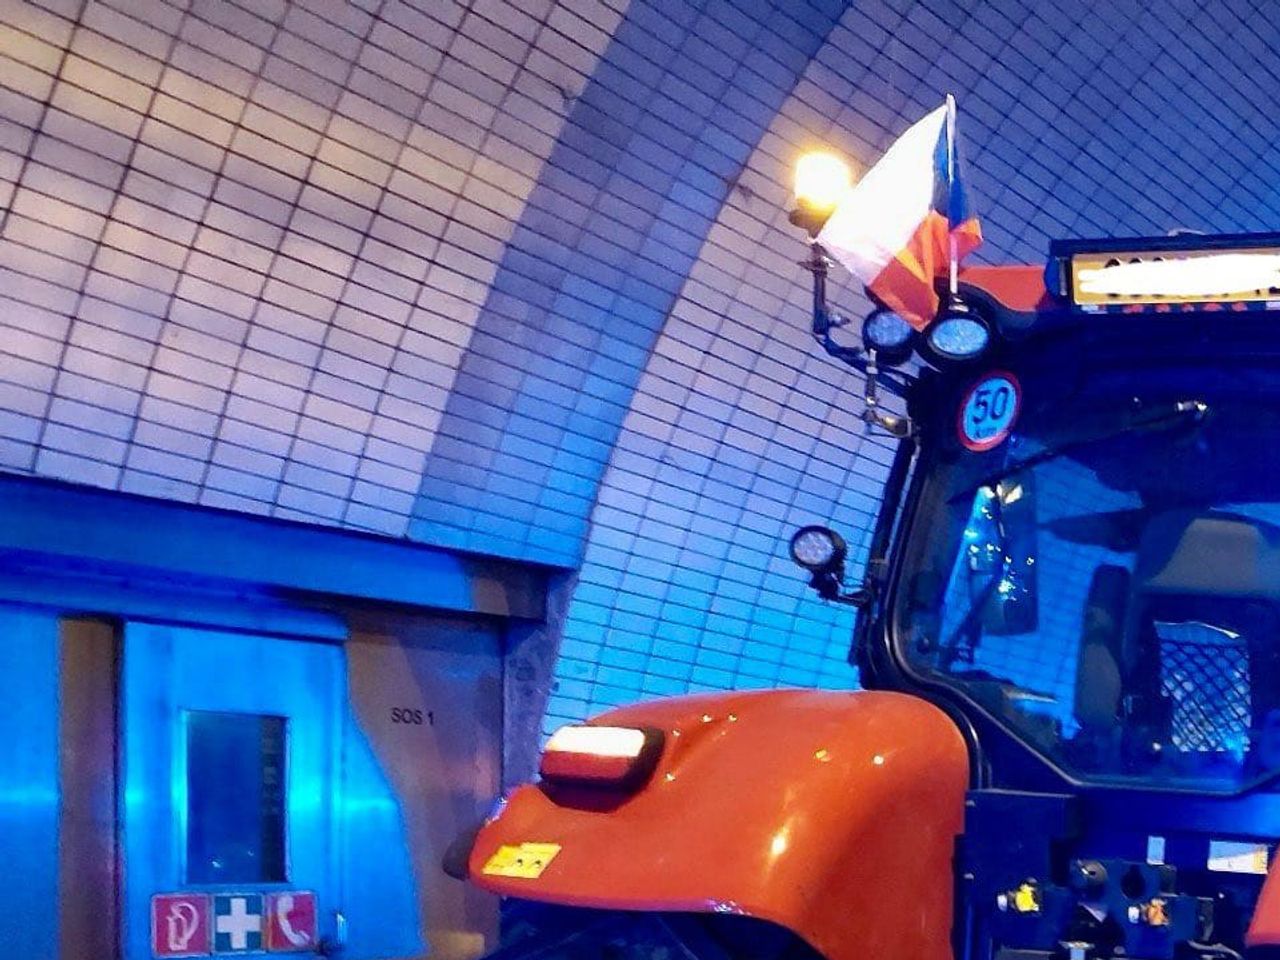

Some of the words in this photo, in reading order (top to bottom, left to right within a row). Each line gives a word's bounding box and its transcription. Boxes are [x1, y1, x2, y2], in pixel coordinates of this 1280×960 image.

[973, 386, 1009, 424] 50
[391, 707, 422, 725] SOS
[428, 711, 434, 726] 1
